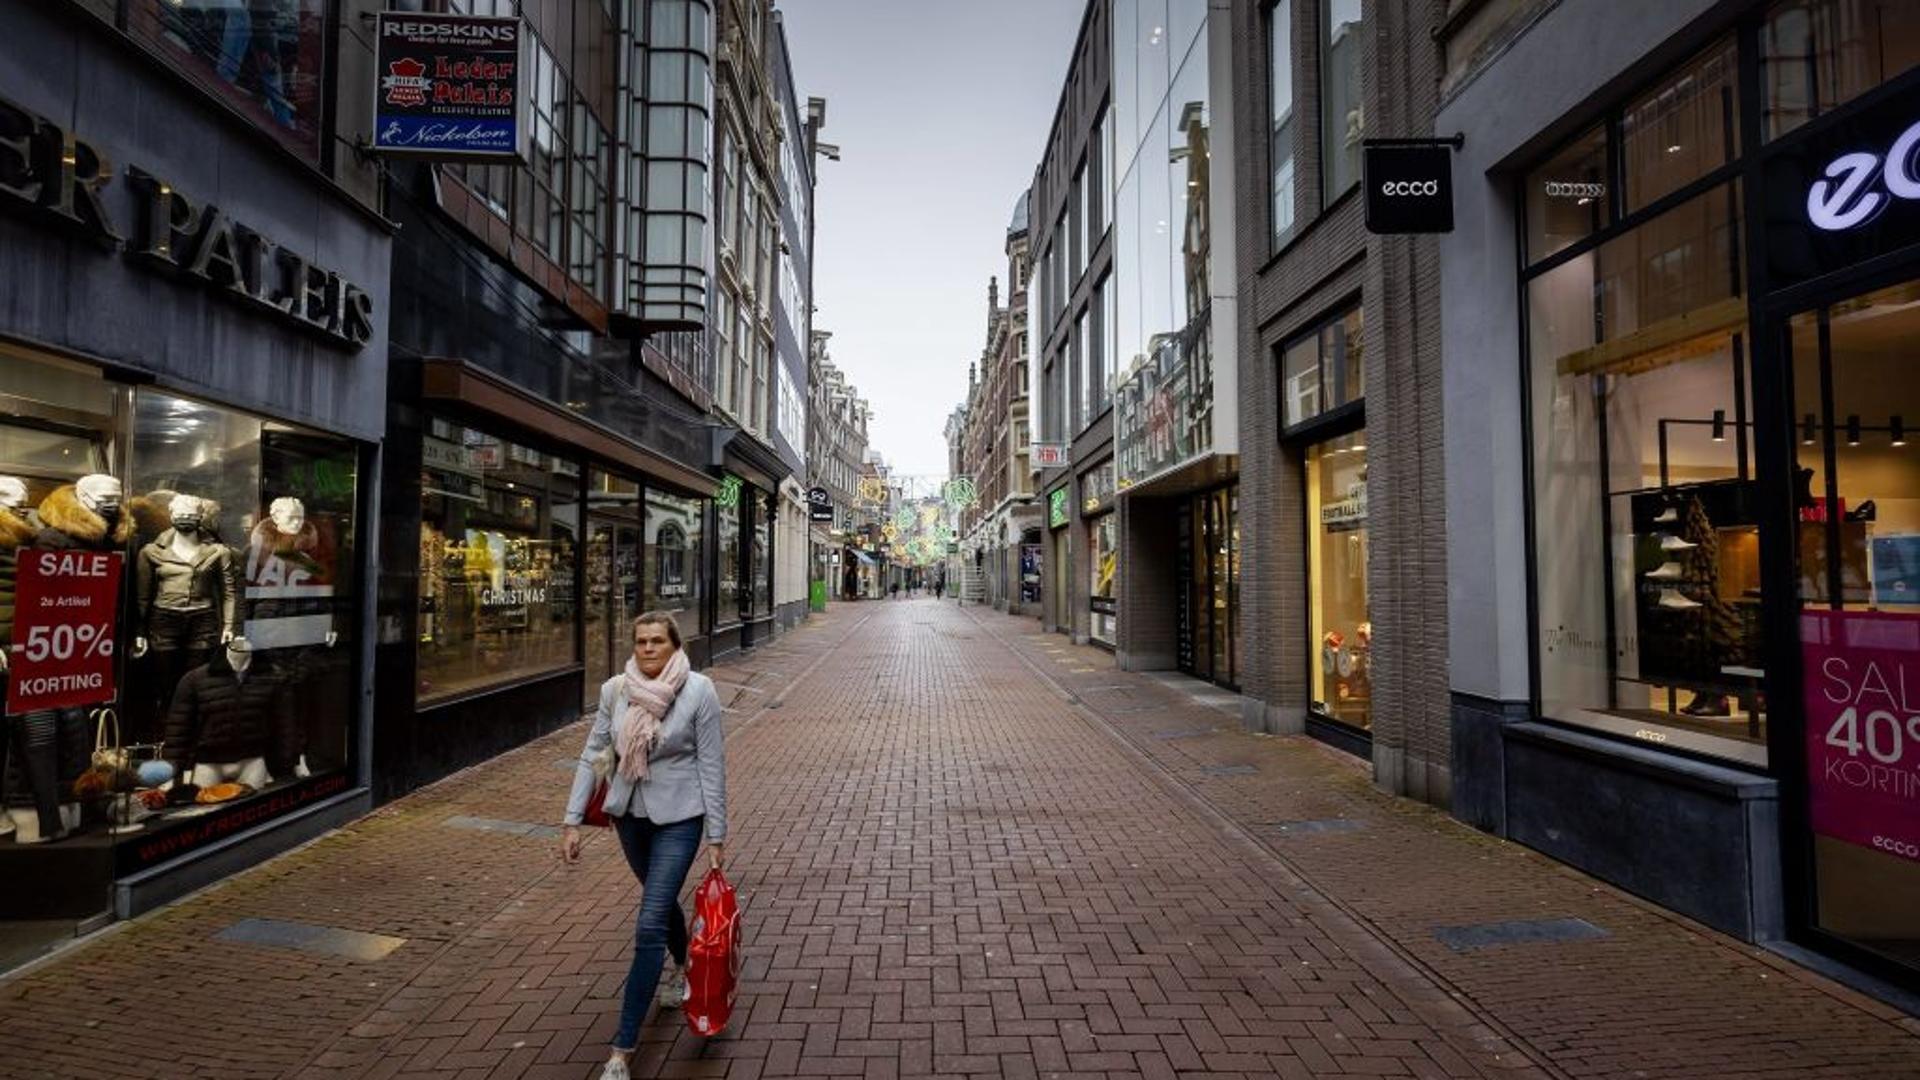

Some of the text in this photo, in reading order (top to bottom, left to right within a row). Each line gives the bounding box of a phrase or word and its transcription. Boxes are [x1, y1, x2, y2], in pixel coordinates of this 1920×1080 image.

[383, 21, 514, 41] REDSKINS
[435, 56, 514, 80] Leder
[432, 81, 513, 106] Palais
[1382, 180, 1438, 196] ecco
[124, 163, 374, 349] PALEIS
[38, 553, 109, 577] SALE
[56, 596, 91, 606] Artikel
[482, 588, 546, 606] CHRISTMAS
[11, 623, 114, 662] -50%
[20, 673, 103, 696] KORTING
[1872, 835, 1919, 858] ecco
